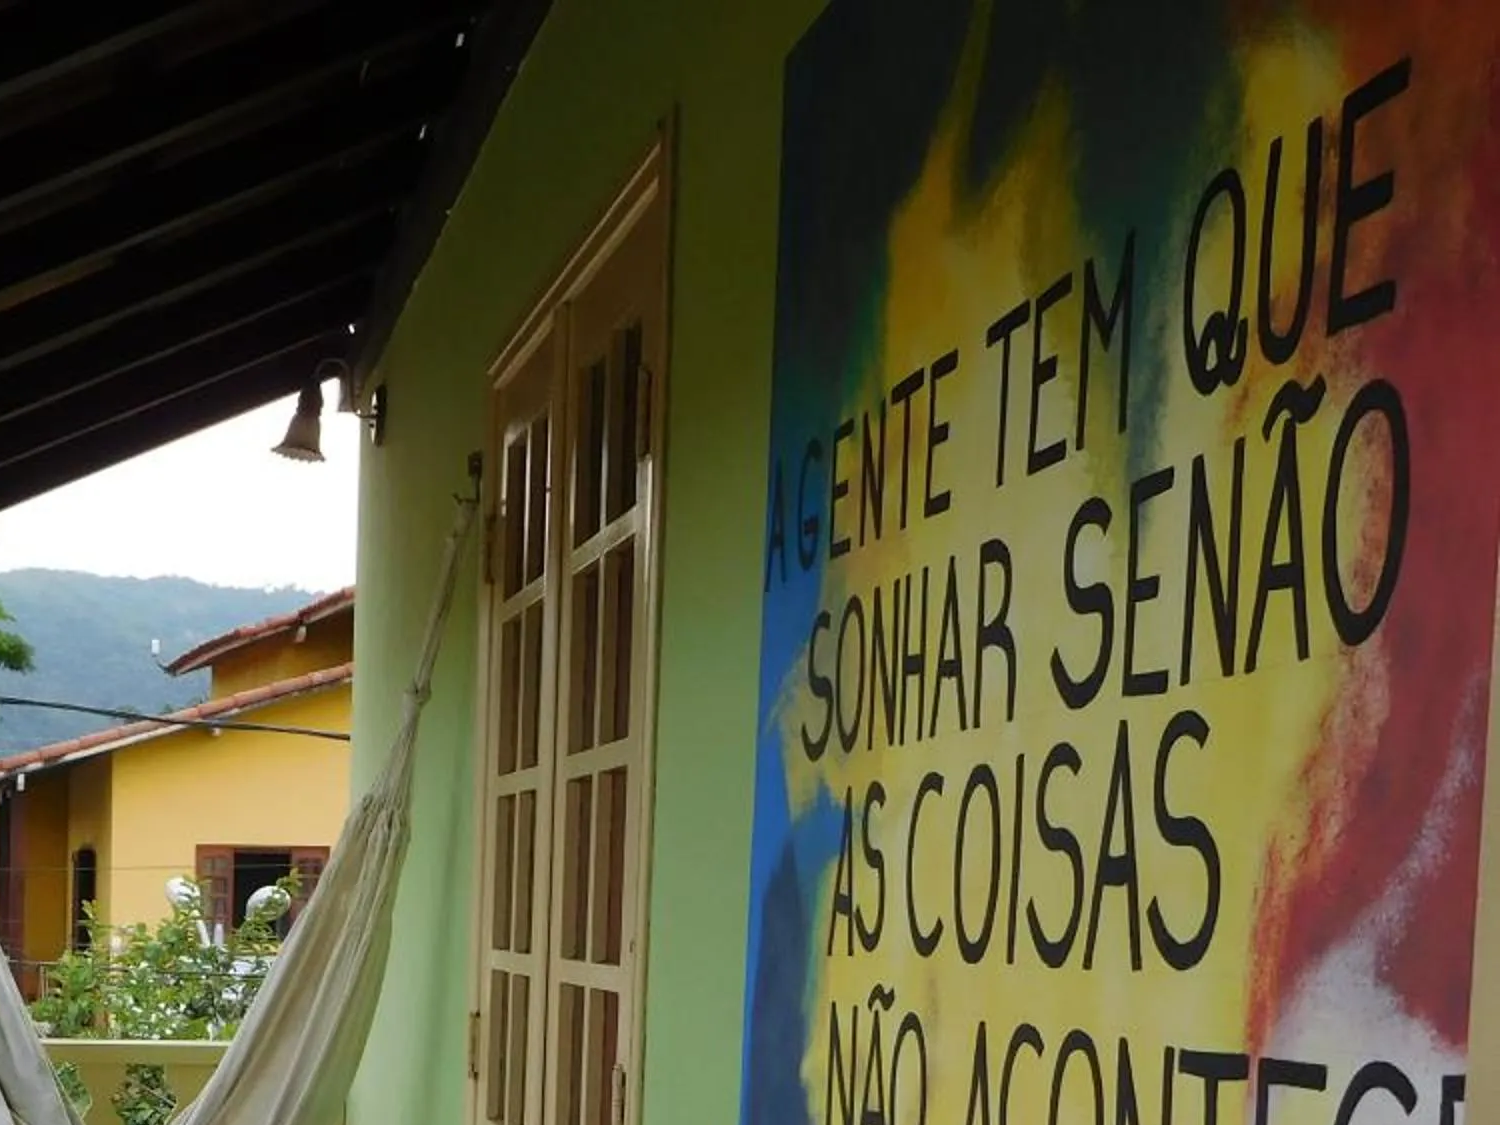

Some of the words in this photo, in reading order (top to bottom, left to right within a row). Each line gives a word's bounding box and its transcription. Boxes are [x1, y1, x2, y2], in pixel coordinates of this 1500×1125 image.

[986, 228, 1135, 488] TEM
[1183, 56, 1412, 397] QUE
[801, 538, 1017, 762] SONHAR
[1050, 375, 1411, 710] SENÃO
[827, 781, 886, 957] AS
[905, 710, 1221, 972] COISAS
